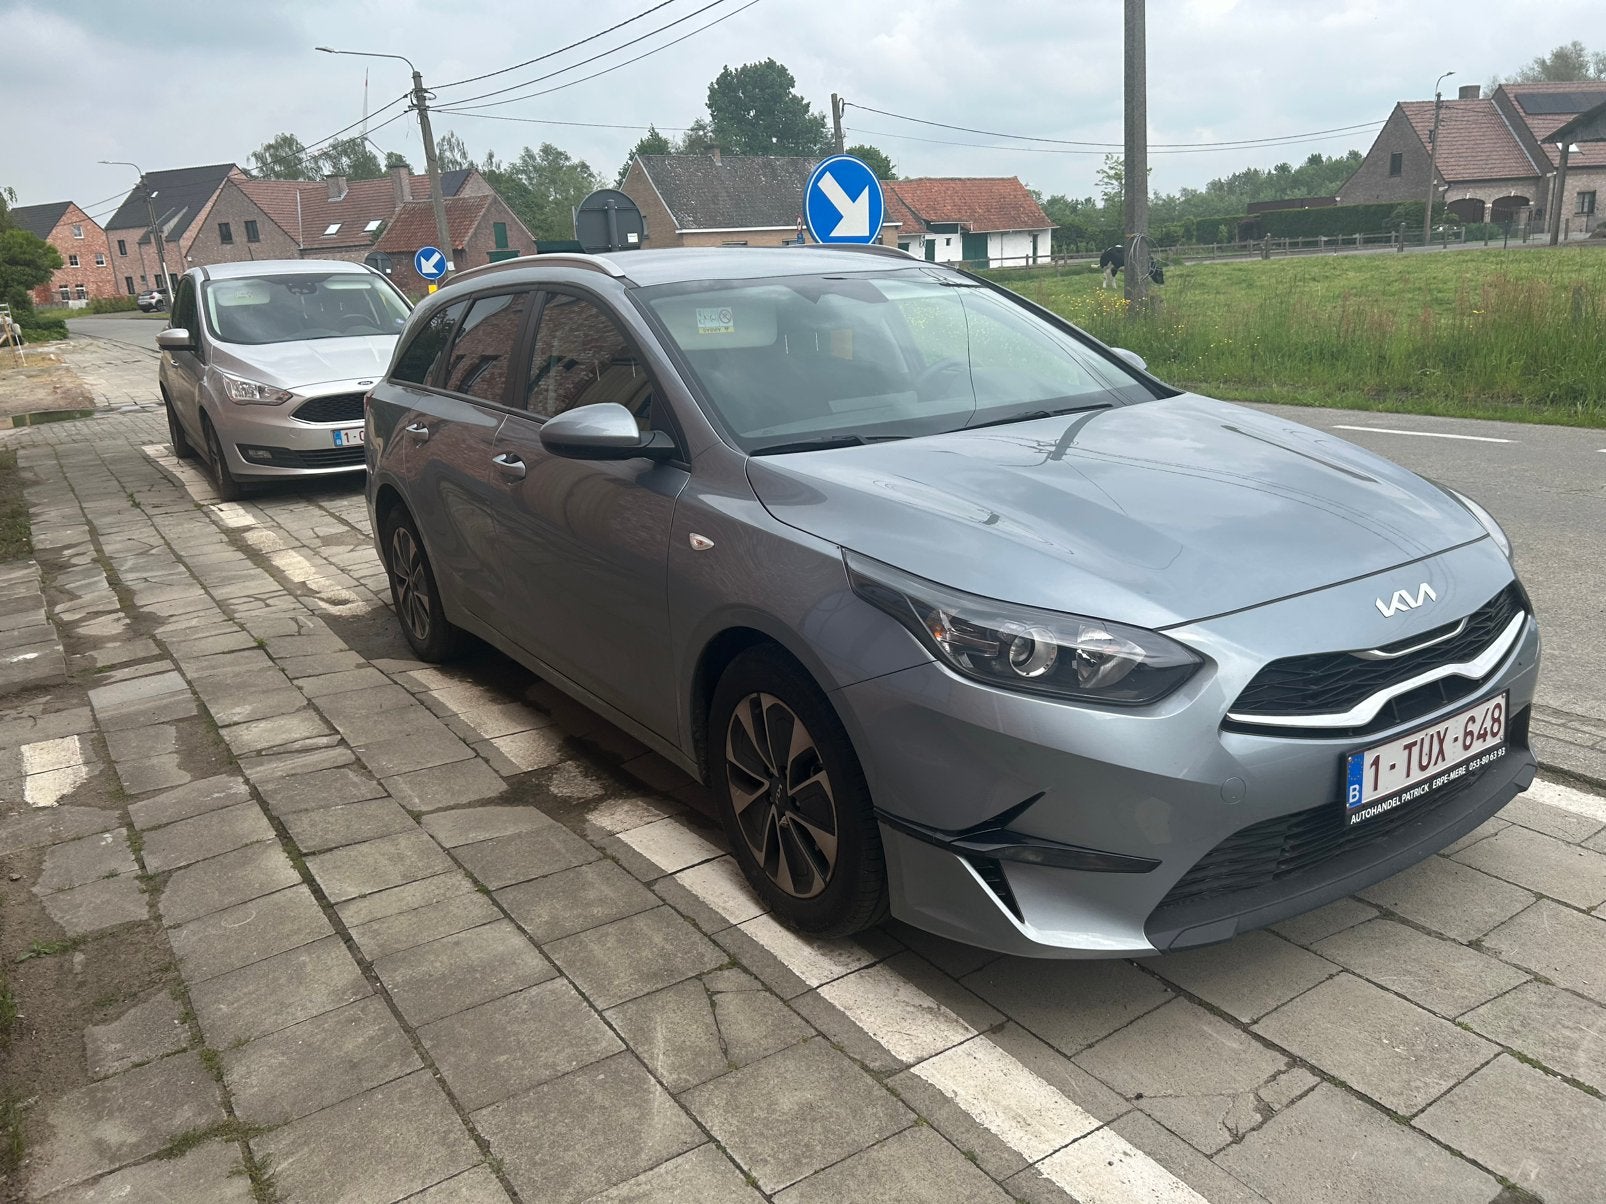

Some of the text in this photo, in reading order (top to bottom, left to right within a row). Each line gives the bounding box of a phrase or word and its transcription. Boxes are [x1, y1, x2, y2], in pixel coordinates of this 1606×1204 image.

[1375, 582, 1437, 618] KIA
[1370, 702, 1503, 792] 1-TUX-648
[1349, 784, 1360, 803] B
[1350, 793, 1401, 825] AUTOHANDEL
[1401, 783, 1430, 803] PATRICK
[1432, 765, 1467, 789] ERPE-MERE
